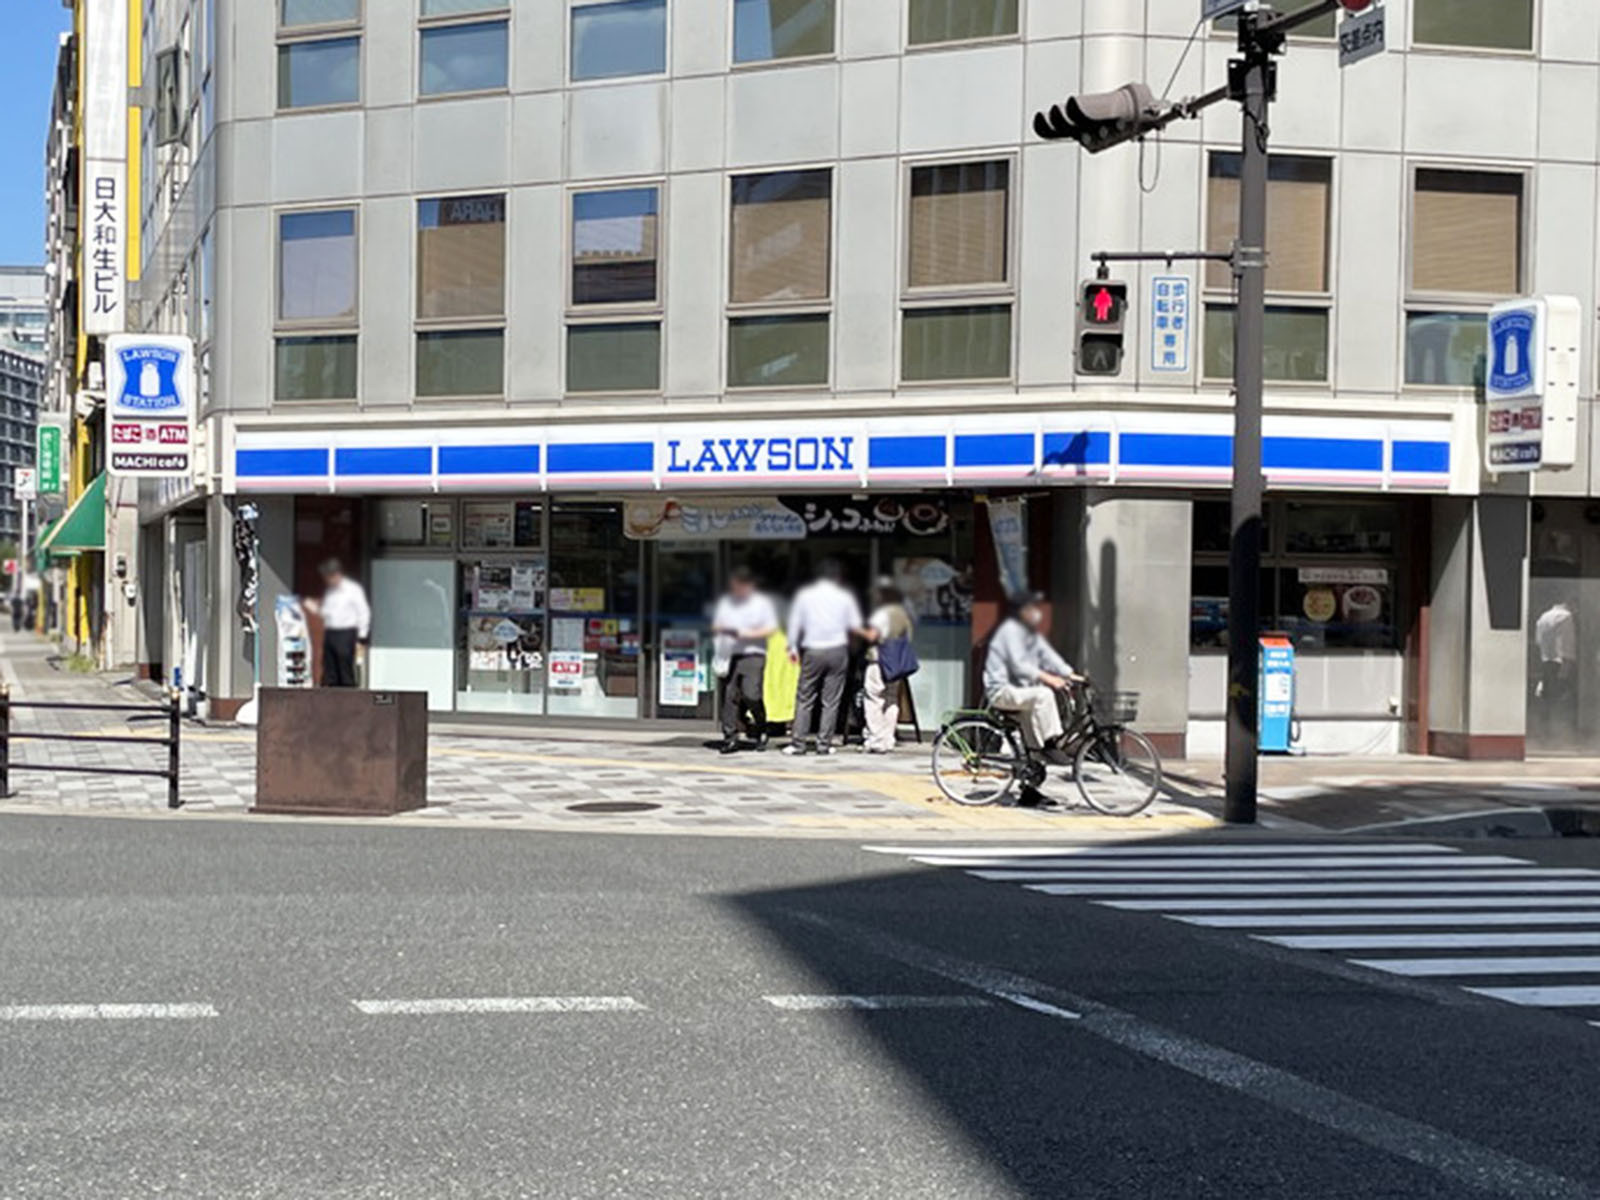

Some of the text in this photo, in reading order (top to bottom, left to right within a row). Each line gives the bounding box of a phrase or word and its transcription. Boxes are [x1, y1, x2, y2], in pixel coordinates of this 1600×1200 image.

[93, 177, 118, 314] 日大和生ビル
[122, 348, 177, 362] LAWSON
[123, 393, 178, 408] STATION
[160, 427, 187, 440] ATM
[667, 437, 854, 472] LAWSON
[115, 456, 157, 468] MACHI
